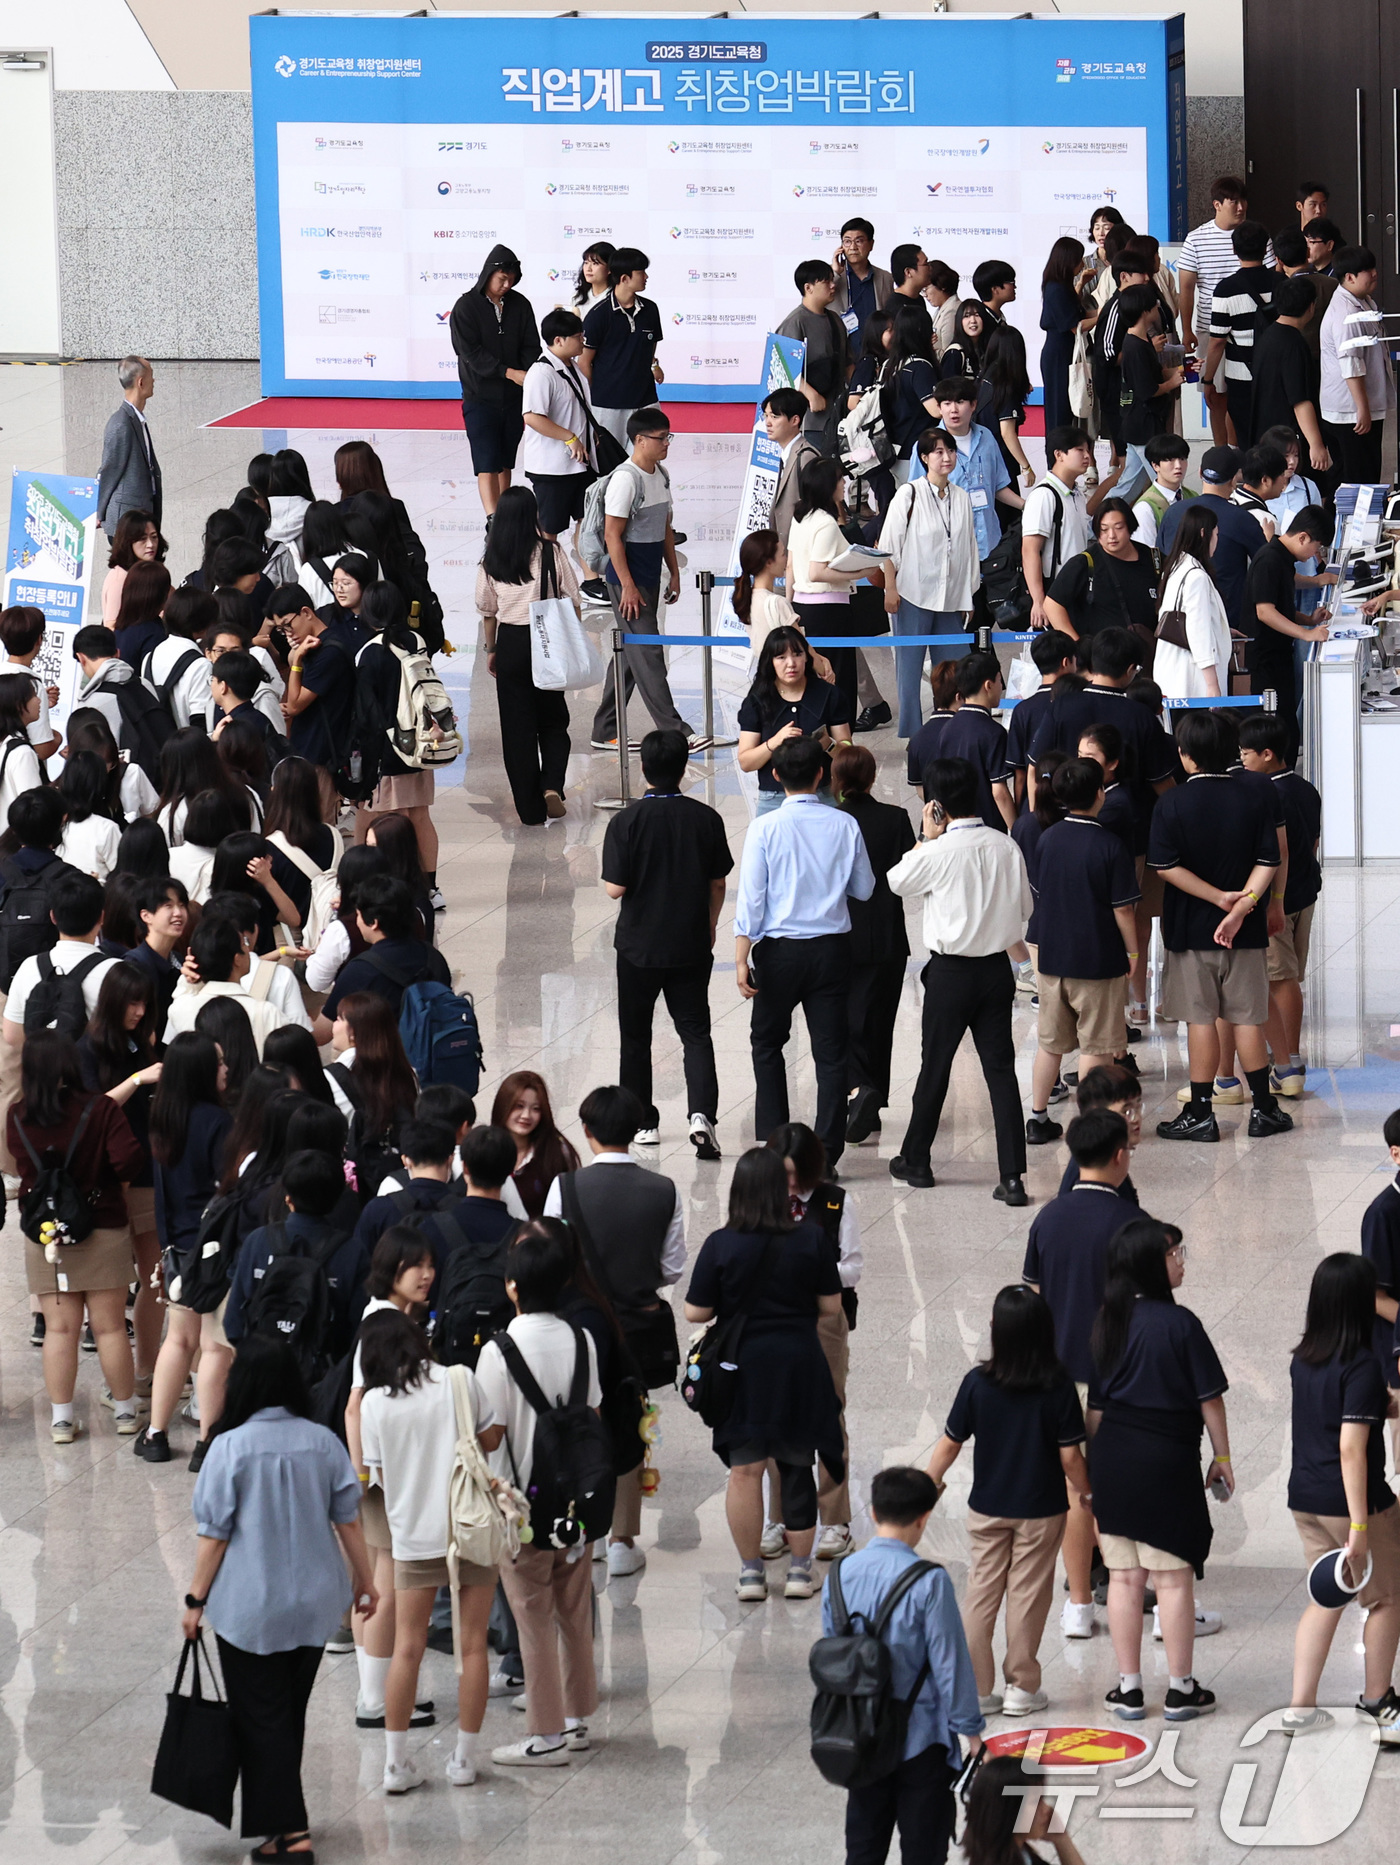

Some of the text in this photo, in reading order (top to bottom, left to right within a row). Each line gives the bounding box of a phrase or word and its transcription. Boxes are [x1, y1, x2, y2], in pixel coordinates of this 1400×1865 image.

[651, 44, 763, 60] 2025 경기도교육청
[299, 57, 422, 71] 경기도교육청 취창업지원센터
[1081, 62, 1147, 74] 경기도교육청
[326, 70, 376, 79] Entrepreneurship
[377, 71, 400, 79] Support
[500, 66, 916, 115] 직업계고 취창업박람회
[328, 139, 364, 147] 경기도교육청
[465, 142, 488, 151] 경기도
[575, 141, 611, 149] 경기도교육청
[927, 148, 978, 157] 한국장애인개발원
[700, 185, 736, 193] 경기도교육청
[433, 230, 455, 239] KBIZ
[577, 227, 613, 235] 경기도교육청
[925, 227, 943, 236] 경기도
[432, 272, 450, 281] 경기도
[702, 271, 738, 279] 경기도교육청
[704, 358, 740, 366] 경기도교육청
[15, 584, 78, 609] 현장등록안내
